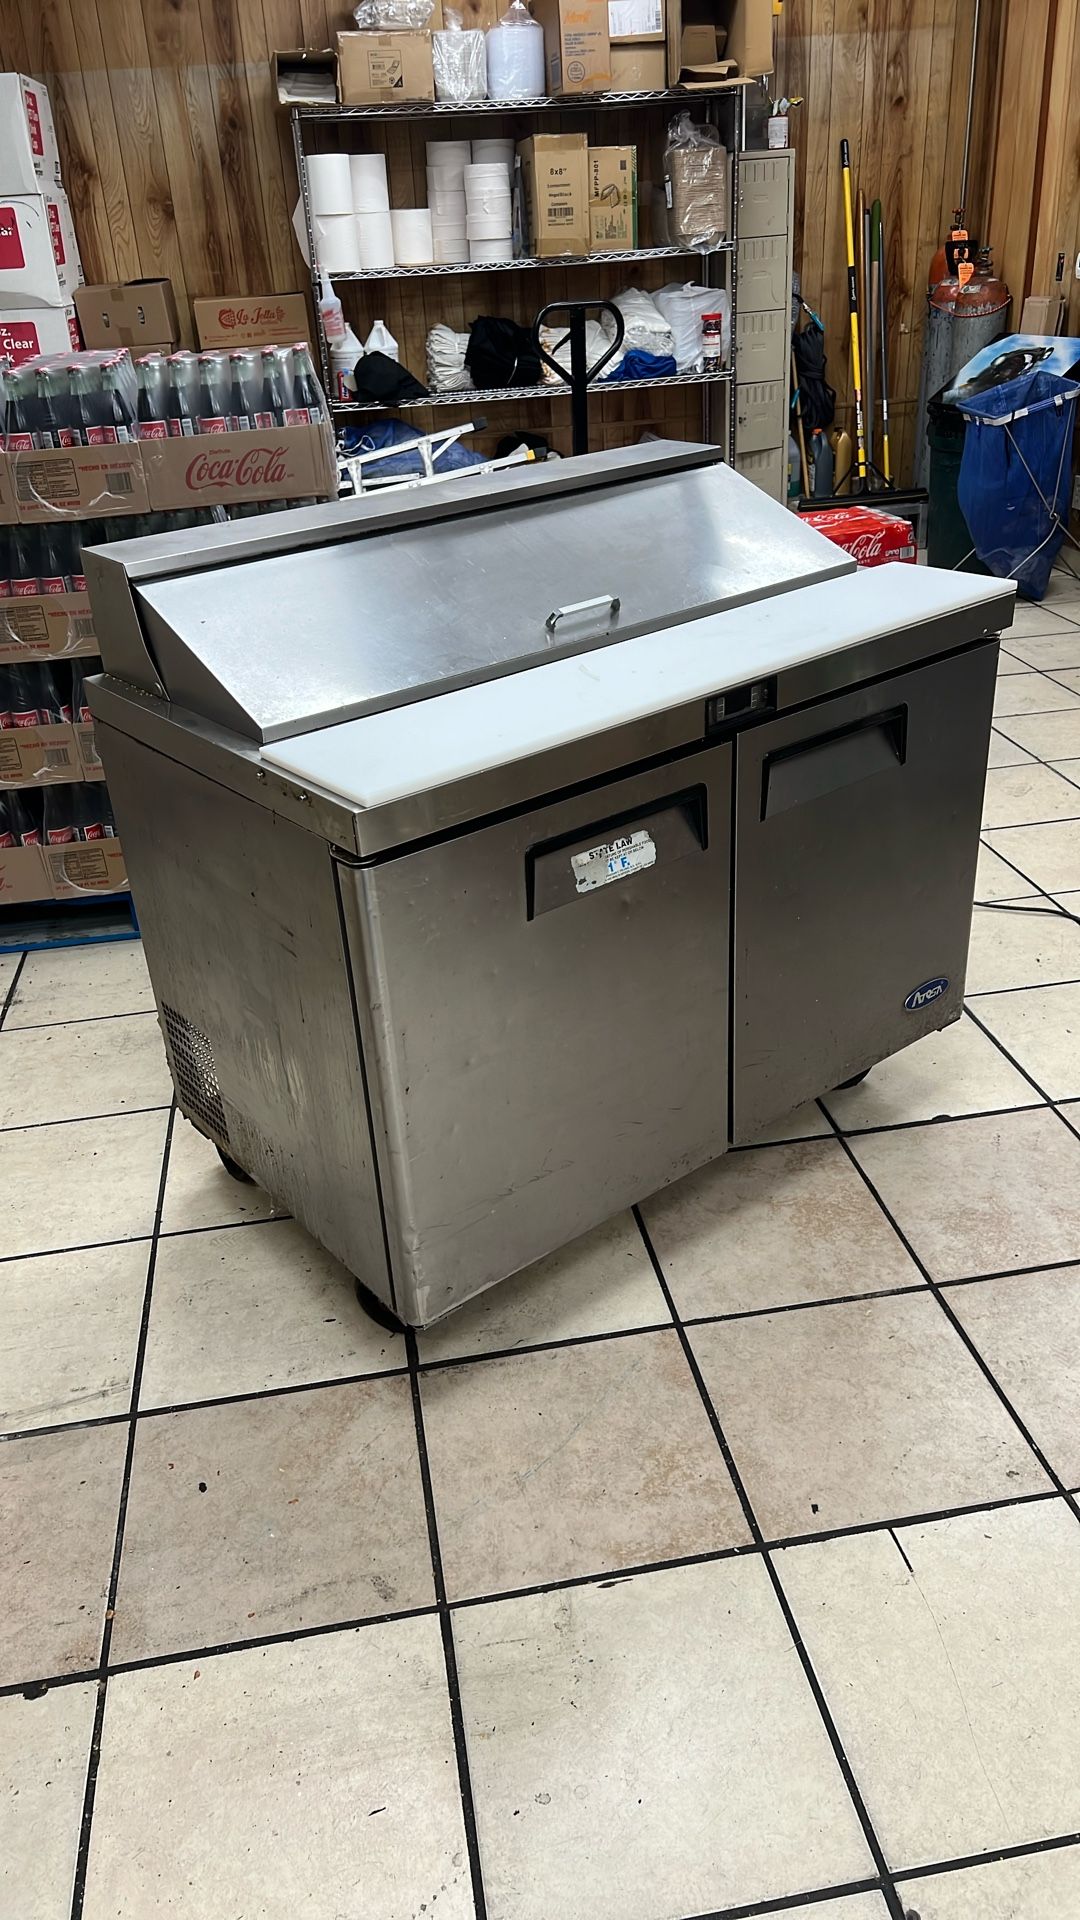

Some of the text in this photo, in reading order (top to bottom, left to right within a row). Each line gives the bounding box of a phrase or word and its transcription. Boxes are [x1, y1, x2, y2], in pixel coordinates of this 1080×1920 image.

[0, 328, 11, 337] z.
[3, 338, 34, 350] Clear
[186, 446, 290, 491] Coca-Cola
[615, 837, 633, 850] LAW
